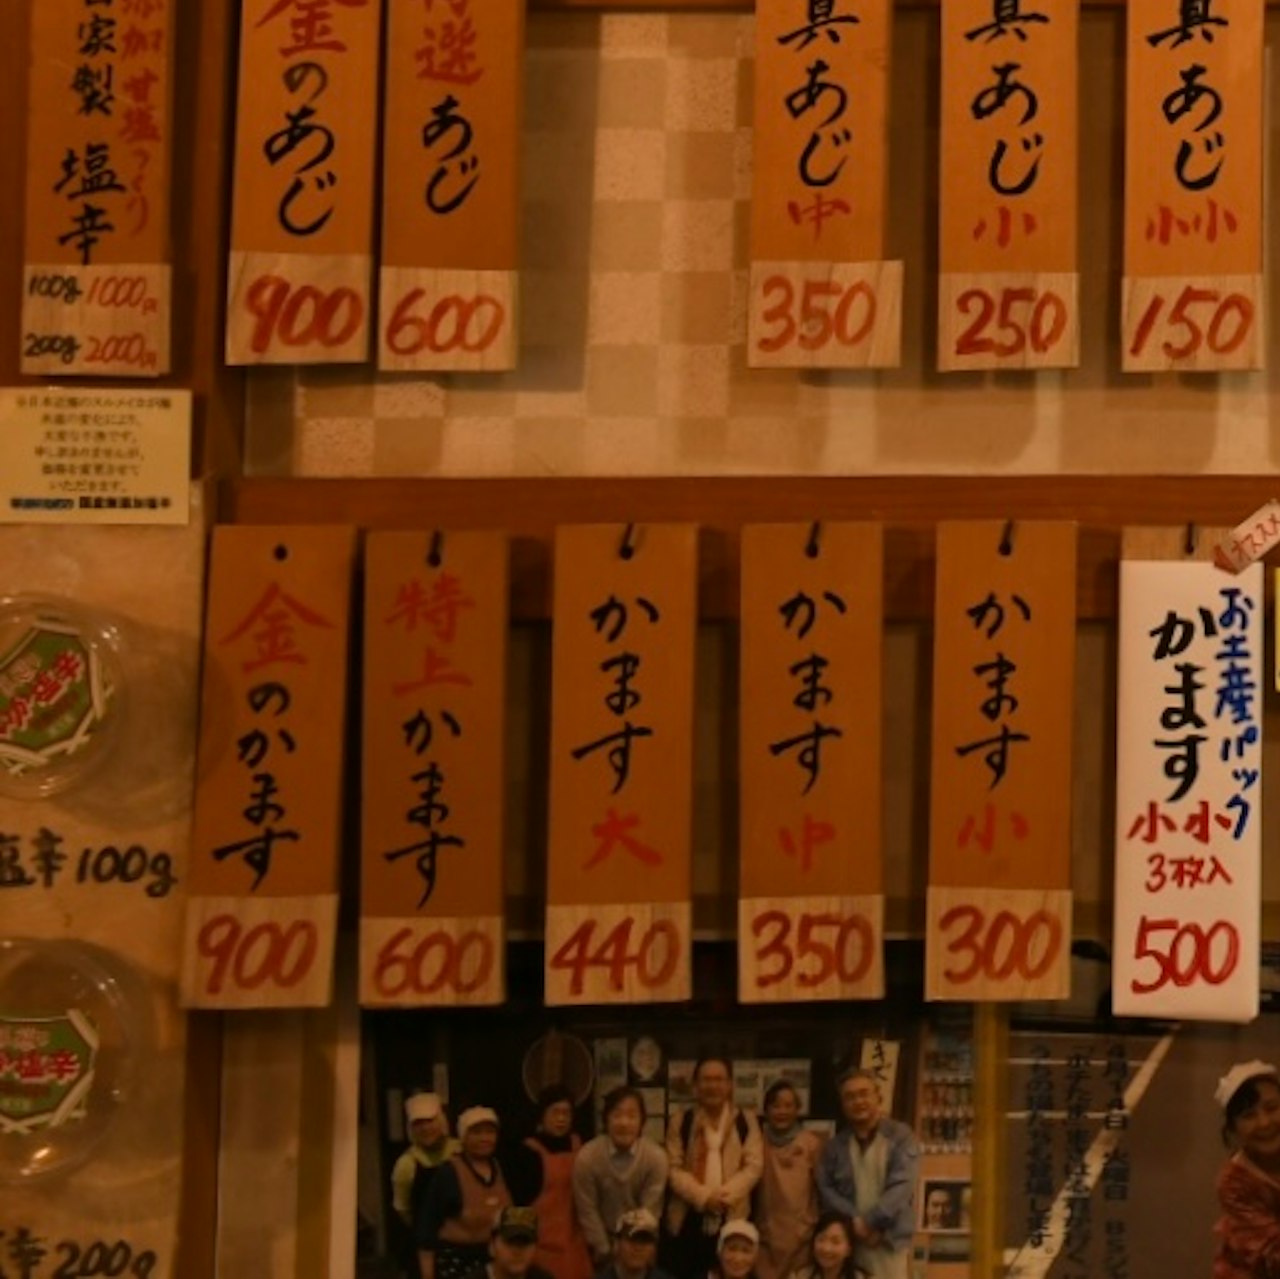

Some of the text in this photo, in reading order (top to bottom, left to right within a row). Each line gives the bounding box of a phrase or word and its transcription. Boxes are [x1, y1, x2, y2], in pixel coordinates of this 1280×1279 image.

[246, 275, 363, 353] 900
[385, 289, 506, 355] 600
[757, 276, 877, 352] 350
[955, 288, 1067, 356] 250
[1130, 286, 1254, 359] 150
[1149, 608, 1218, 803] かます
[198, 914, 318, 995] 900
[375, 926, 493, 997] 600
[551, 918, 680, 995] 440
[752, 910, 874, 988] 350
[939, 905, 1061, 984] 300
[1130, 916, 1240, 994] 500
